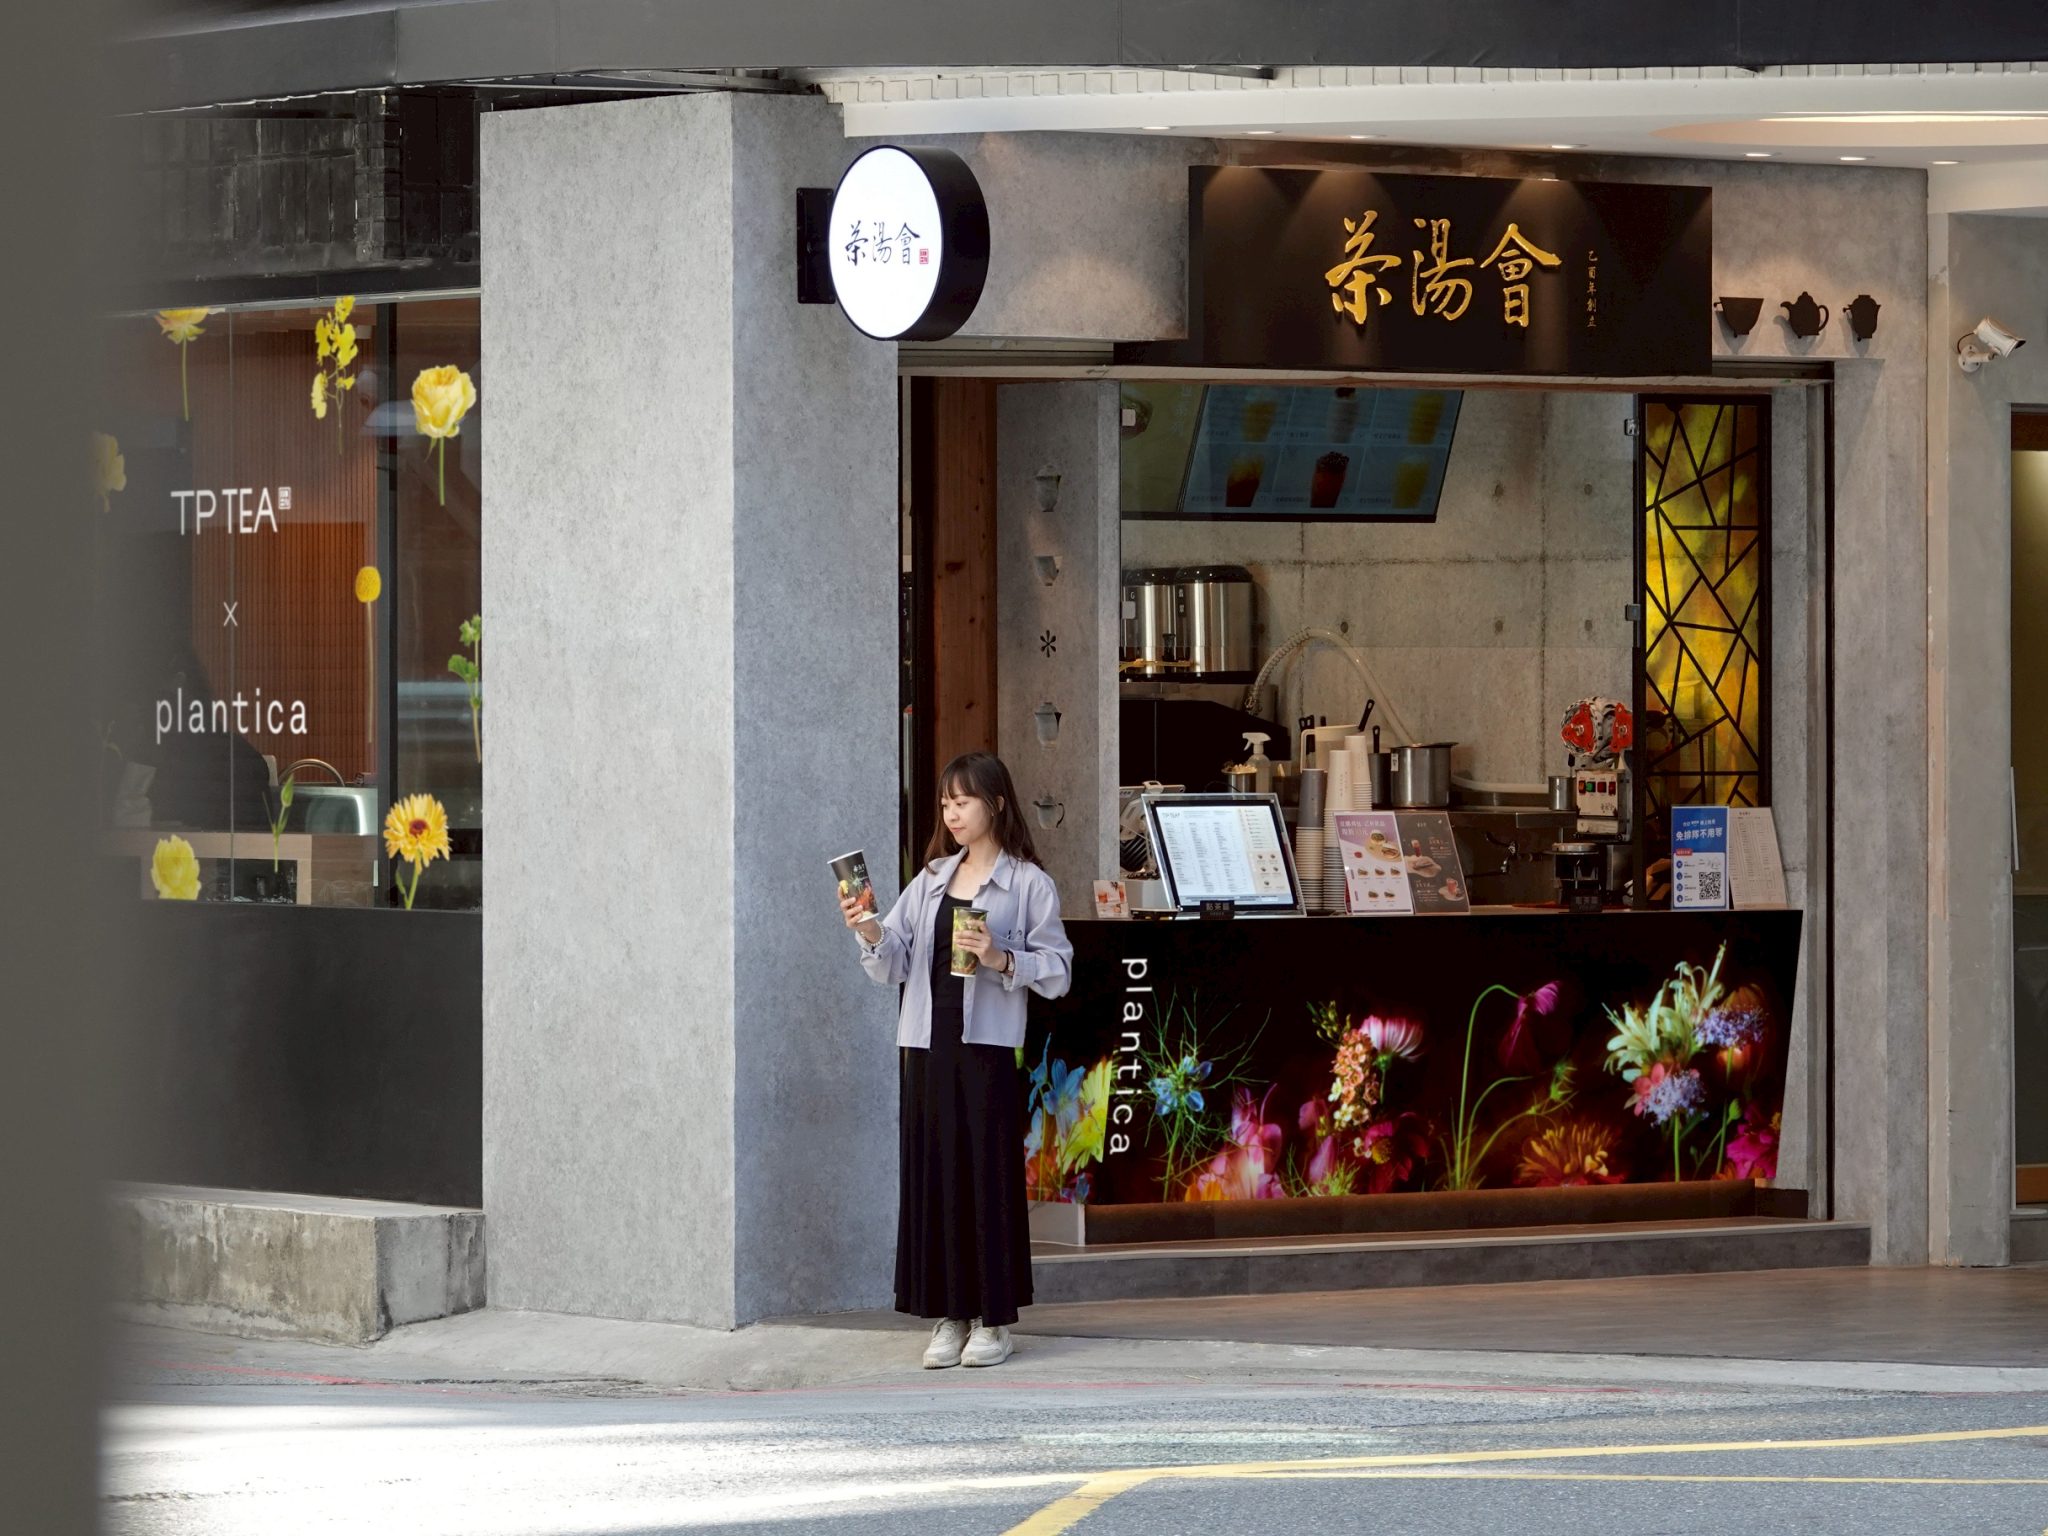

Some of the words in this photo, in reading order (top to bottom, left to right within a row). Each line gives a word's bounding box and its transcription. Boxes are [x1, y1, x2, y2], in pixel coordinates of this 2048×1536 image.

[845, 220, 921, 266] 茶湯會
[1325, 210, 1562, 325] 茶湯會
[170, 490, 216, 535] TP
[222, 487, 278, 533] TEA
[156, 687, 308, 745] plantica
[1110, 958, 1153, 1155] plantica
